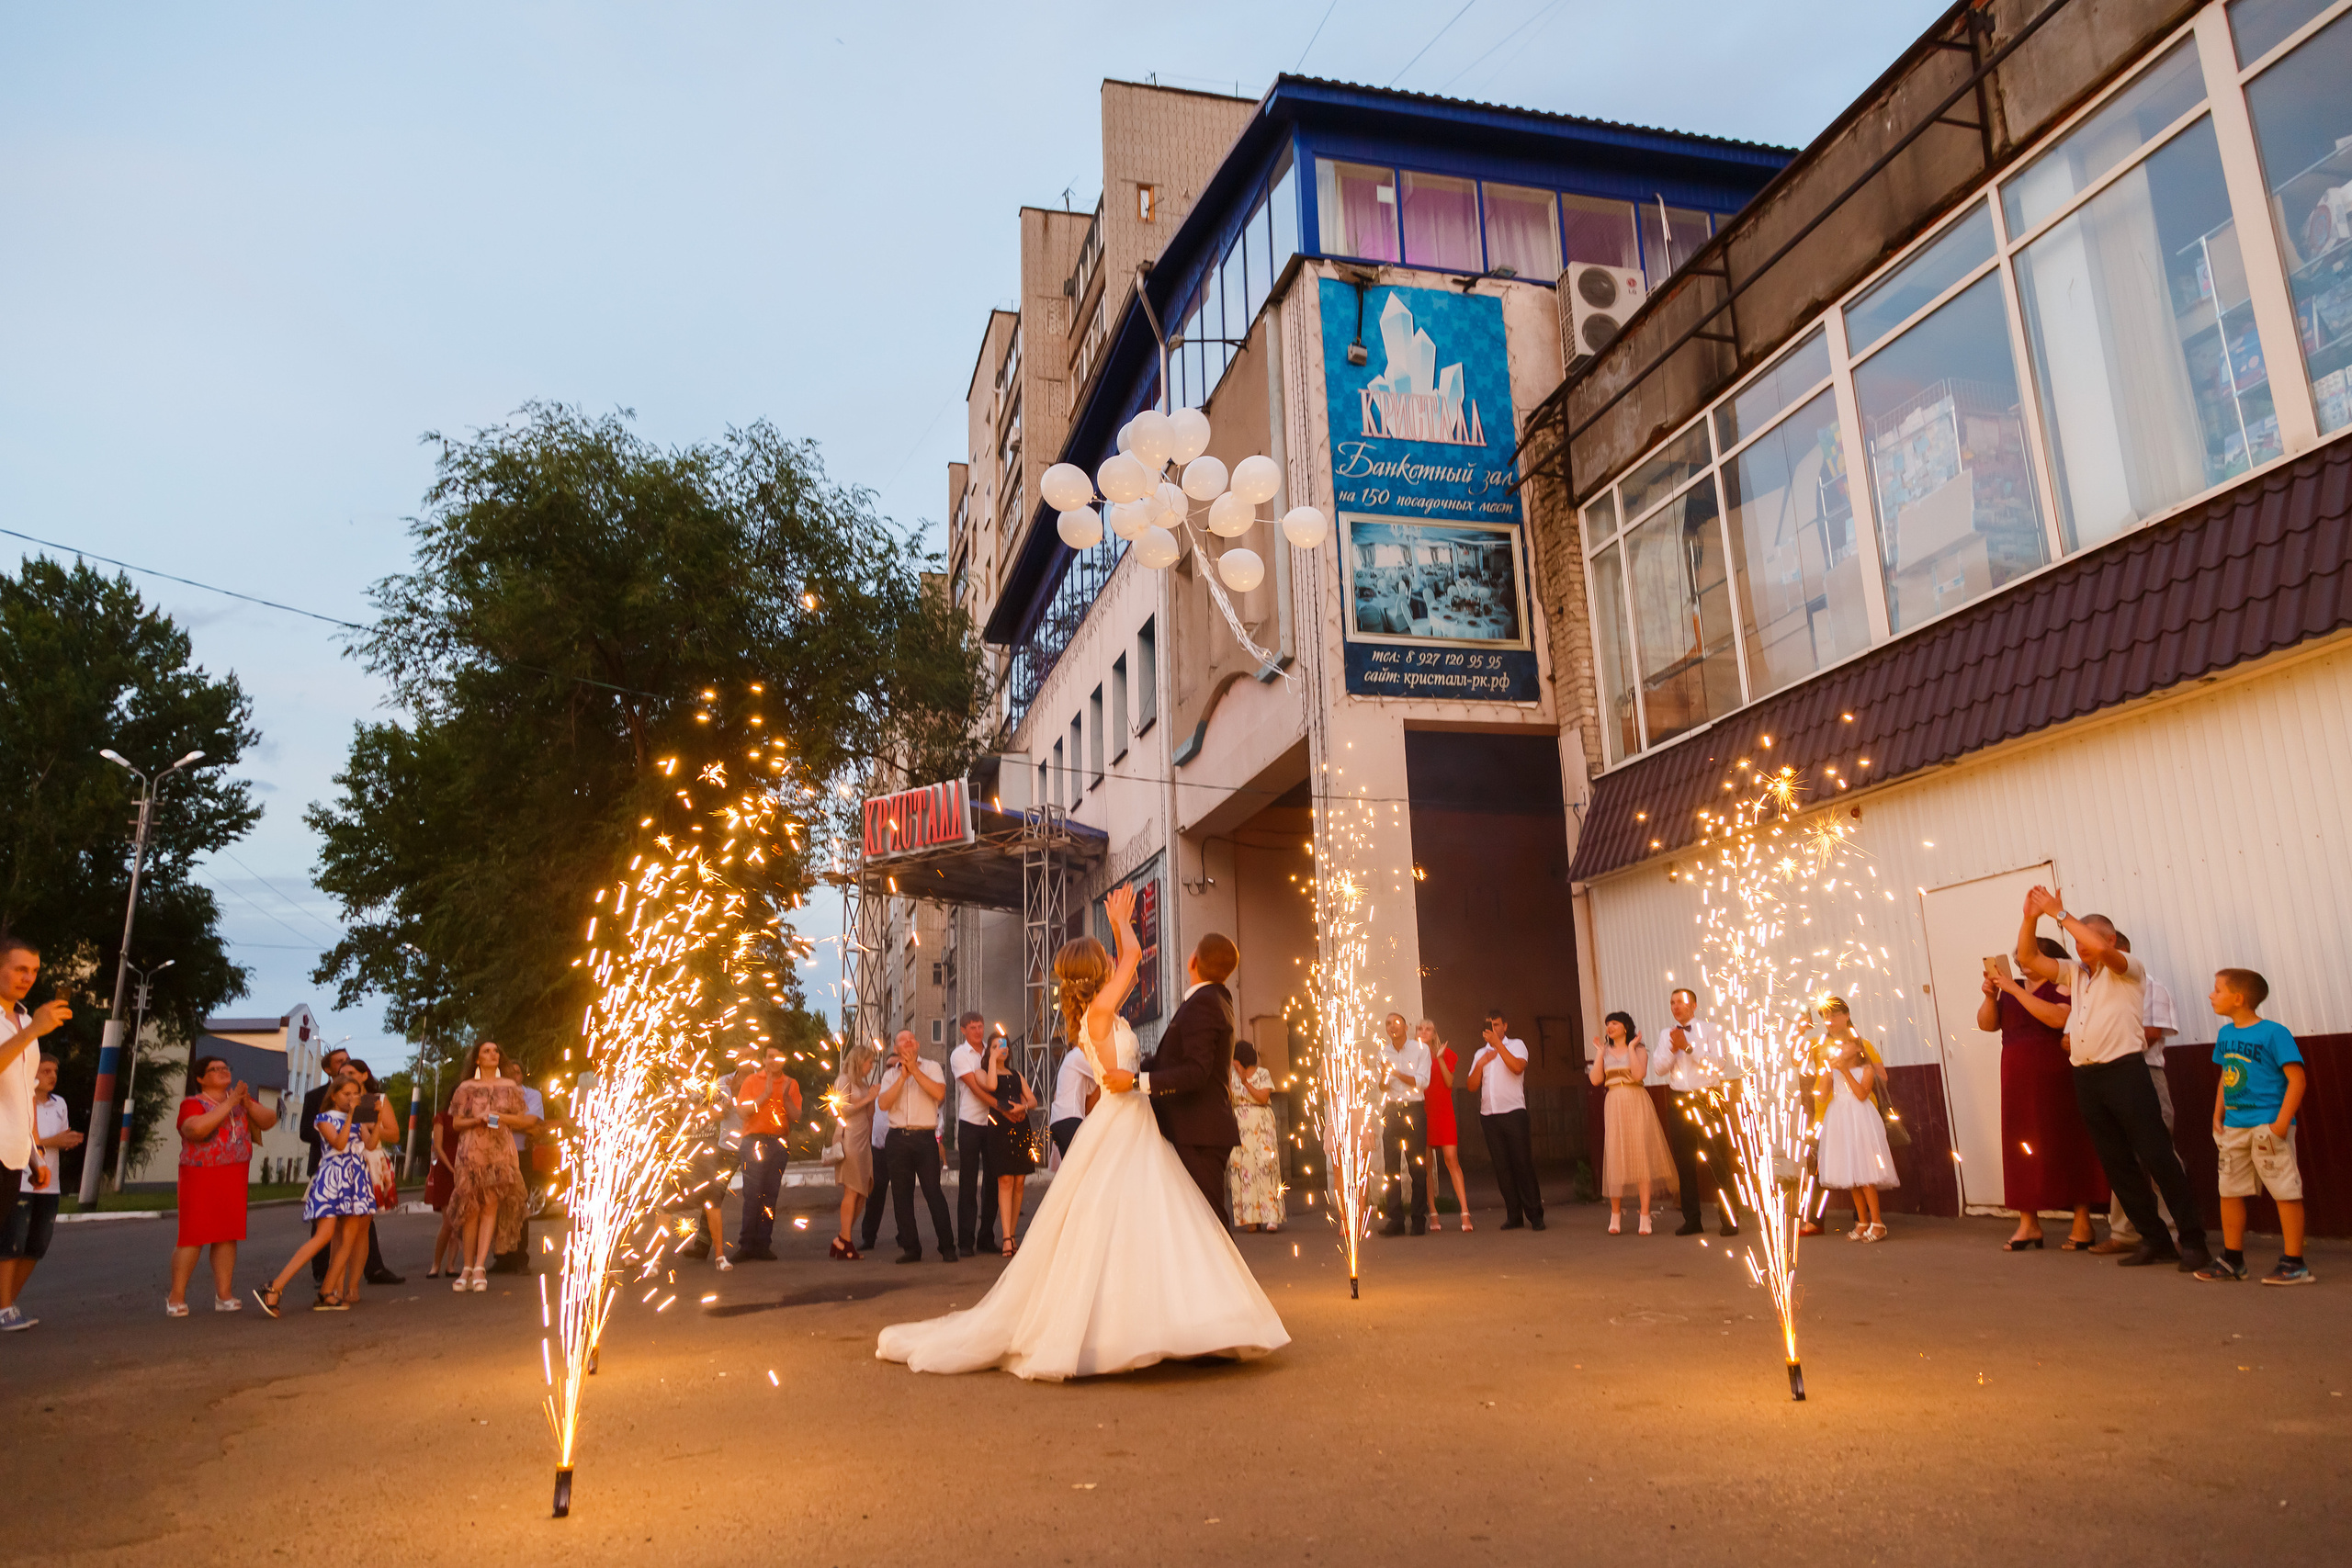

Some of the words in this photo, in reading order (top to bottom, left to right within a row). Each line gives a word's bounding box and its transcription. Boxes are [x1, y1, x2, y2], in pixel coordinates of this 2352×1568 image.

[1358, 389, 1487, 446] КРИСТАЛЛ
[1335, 441, 1477, 486] Банкетный
[1468, 469, 1514, 495] зал
[1339, 489, 1356, 502] на
[1362, 488, 1390, 507] 150
[1396, 495, 1473, 514] посадочных
[1479, 502, 1514, 514] мест
[1372, 649, 1400, 663] тел:
[1406, 649, 1415, 663] 8
[1416, 651, 1442, 667] 927
[1444, 653, 1464, 666] 120
[1466, 654, 1484, 670] 95
[1486, 655, 1503, 670] 95
[1363, 667, 1400, 682] сайт:
[1403, 671, 1510, 693] кристалл-рк.рф
[863, 780, 964, 856] КРИСТАЛЛ
